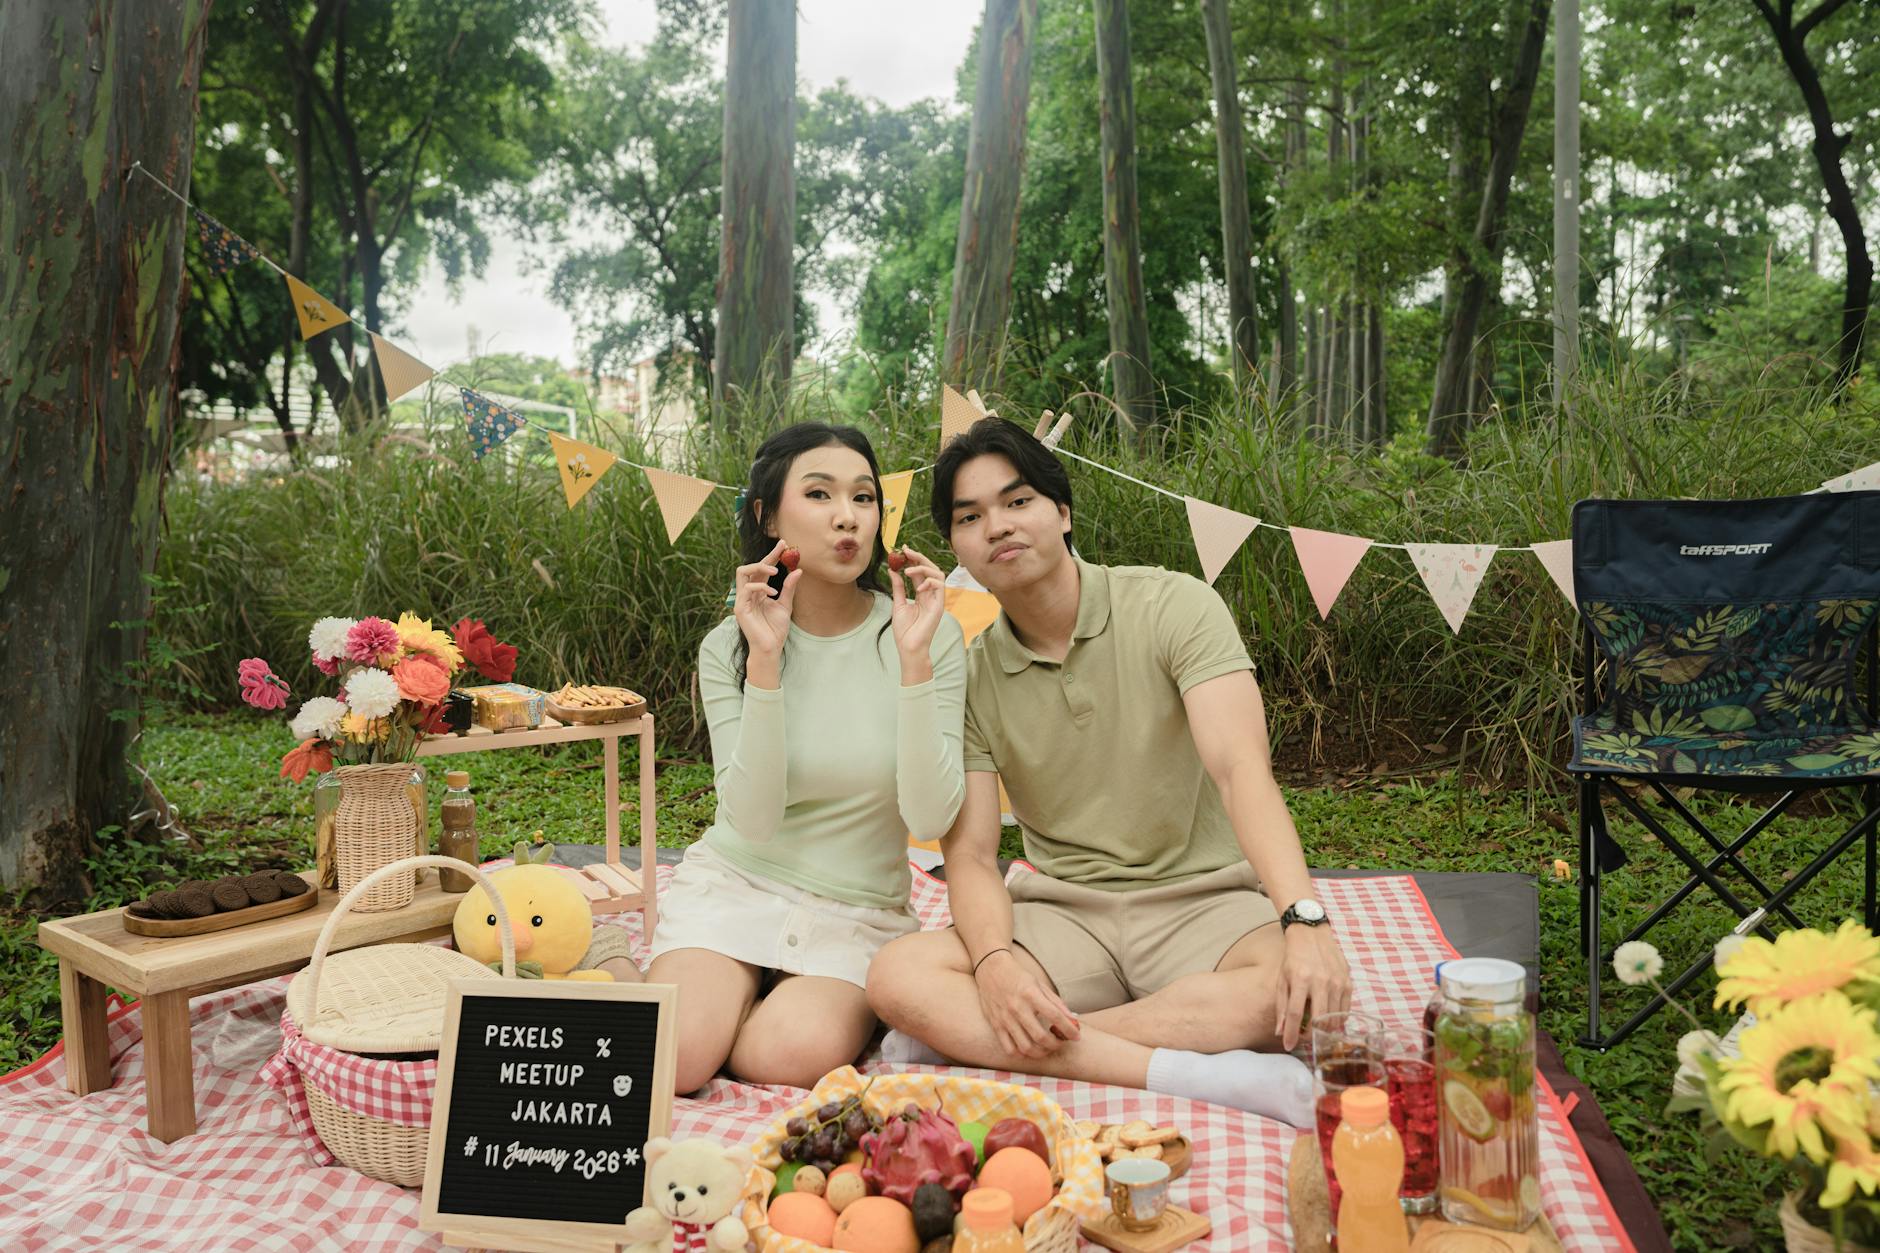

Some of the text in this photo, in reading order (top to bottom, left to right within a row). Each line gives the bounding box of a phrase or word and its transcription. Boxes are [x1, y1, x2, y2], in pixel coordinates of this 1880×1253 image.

[485, 1025, 612, 1058] PEXELS %
[500, 1062, 584, 1087] MEETUP
[511, 1100, 612, 1126] JAKARTA
[464, 1136, 478, 1157] #
[485, 1144, 500, 1167] 11
[503, 1141, 570, 1173] January
